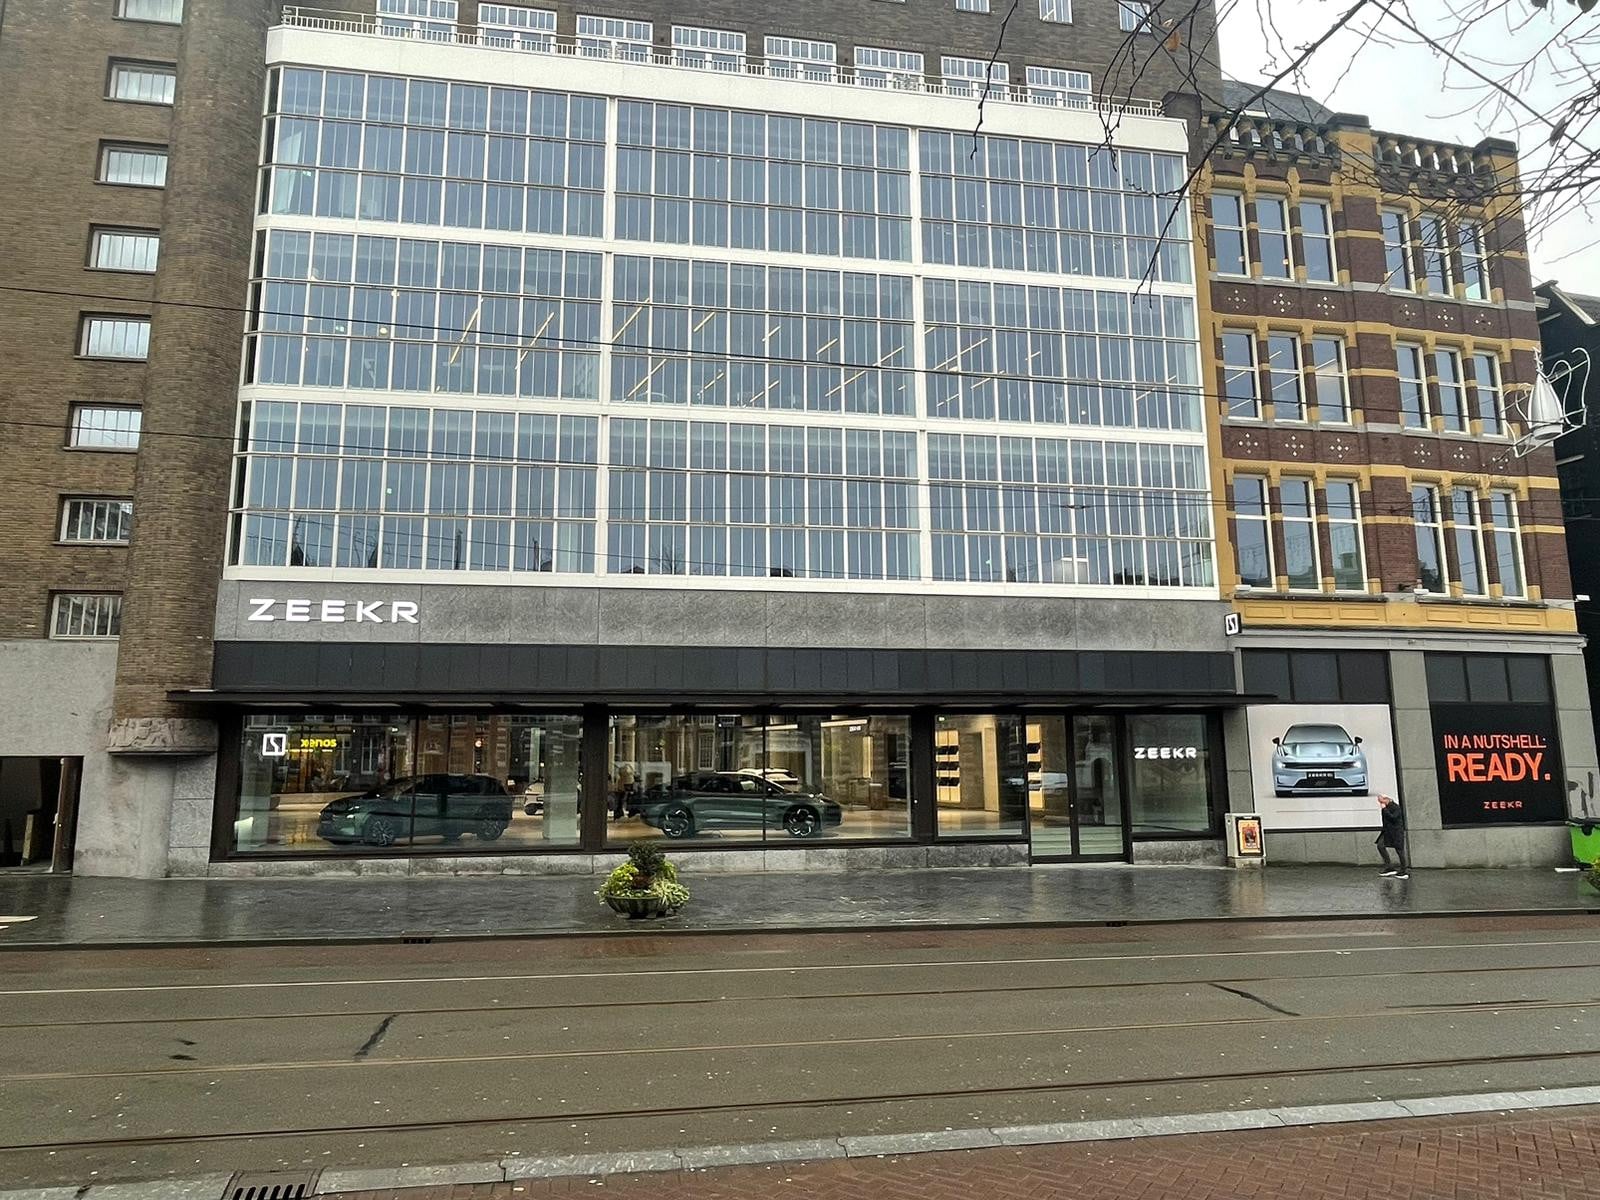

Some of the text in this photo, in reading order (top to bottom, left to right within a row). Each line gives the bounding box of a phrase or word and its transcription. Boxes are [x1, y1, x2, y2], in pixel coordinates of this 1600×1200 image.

[248, 598, 419, 624] ZEEKR
[1444, 734, 1459, 749] IN
[1461, 734, 1472, 749] A
[1134, 747, 1197, 760] ZEEKR
[1447, 752, 1551, 782] READY.
[1483, 800, 1523, 810] ZEEKR
